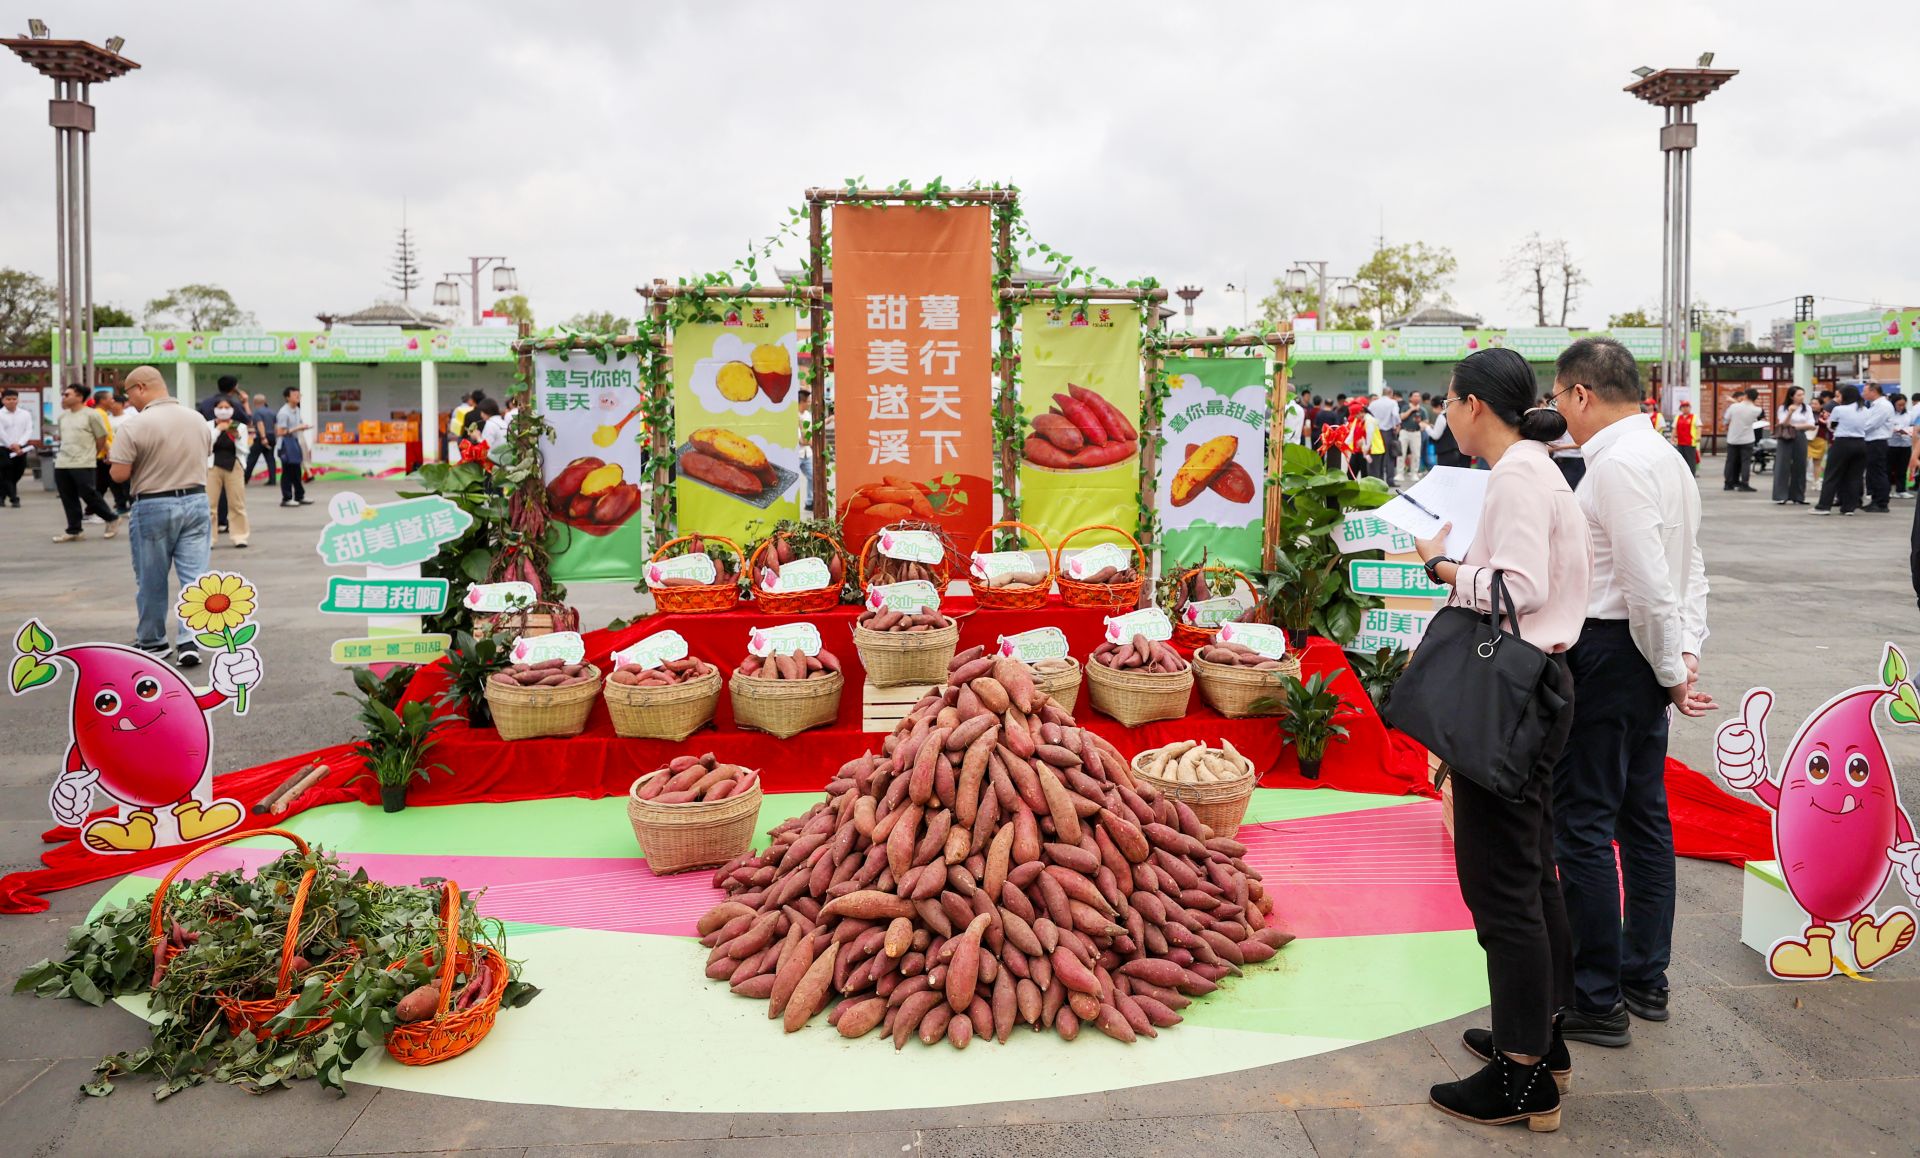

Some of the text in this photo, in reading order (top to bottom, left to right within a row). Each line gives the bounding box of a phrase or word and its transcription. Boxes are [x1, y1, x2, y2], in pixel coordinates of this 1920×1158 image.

[546, 369, 632, 388] 薯与你的
[866, 294, 910, 465] 甜美遂溪
[919, 294, 961, 465] 薯行天下
[546, 393, 590, 411] 春天
[1168, 399, 1264, 434] 薯你最甜美
[332, 508, 456, 562] 甜美遂溪
[334, 585, 442, 610] 薯薯我啊
